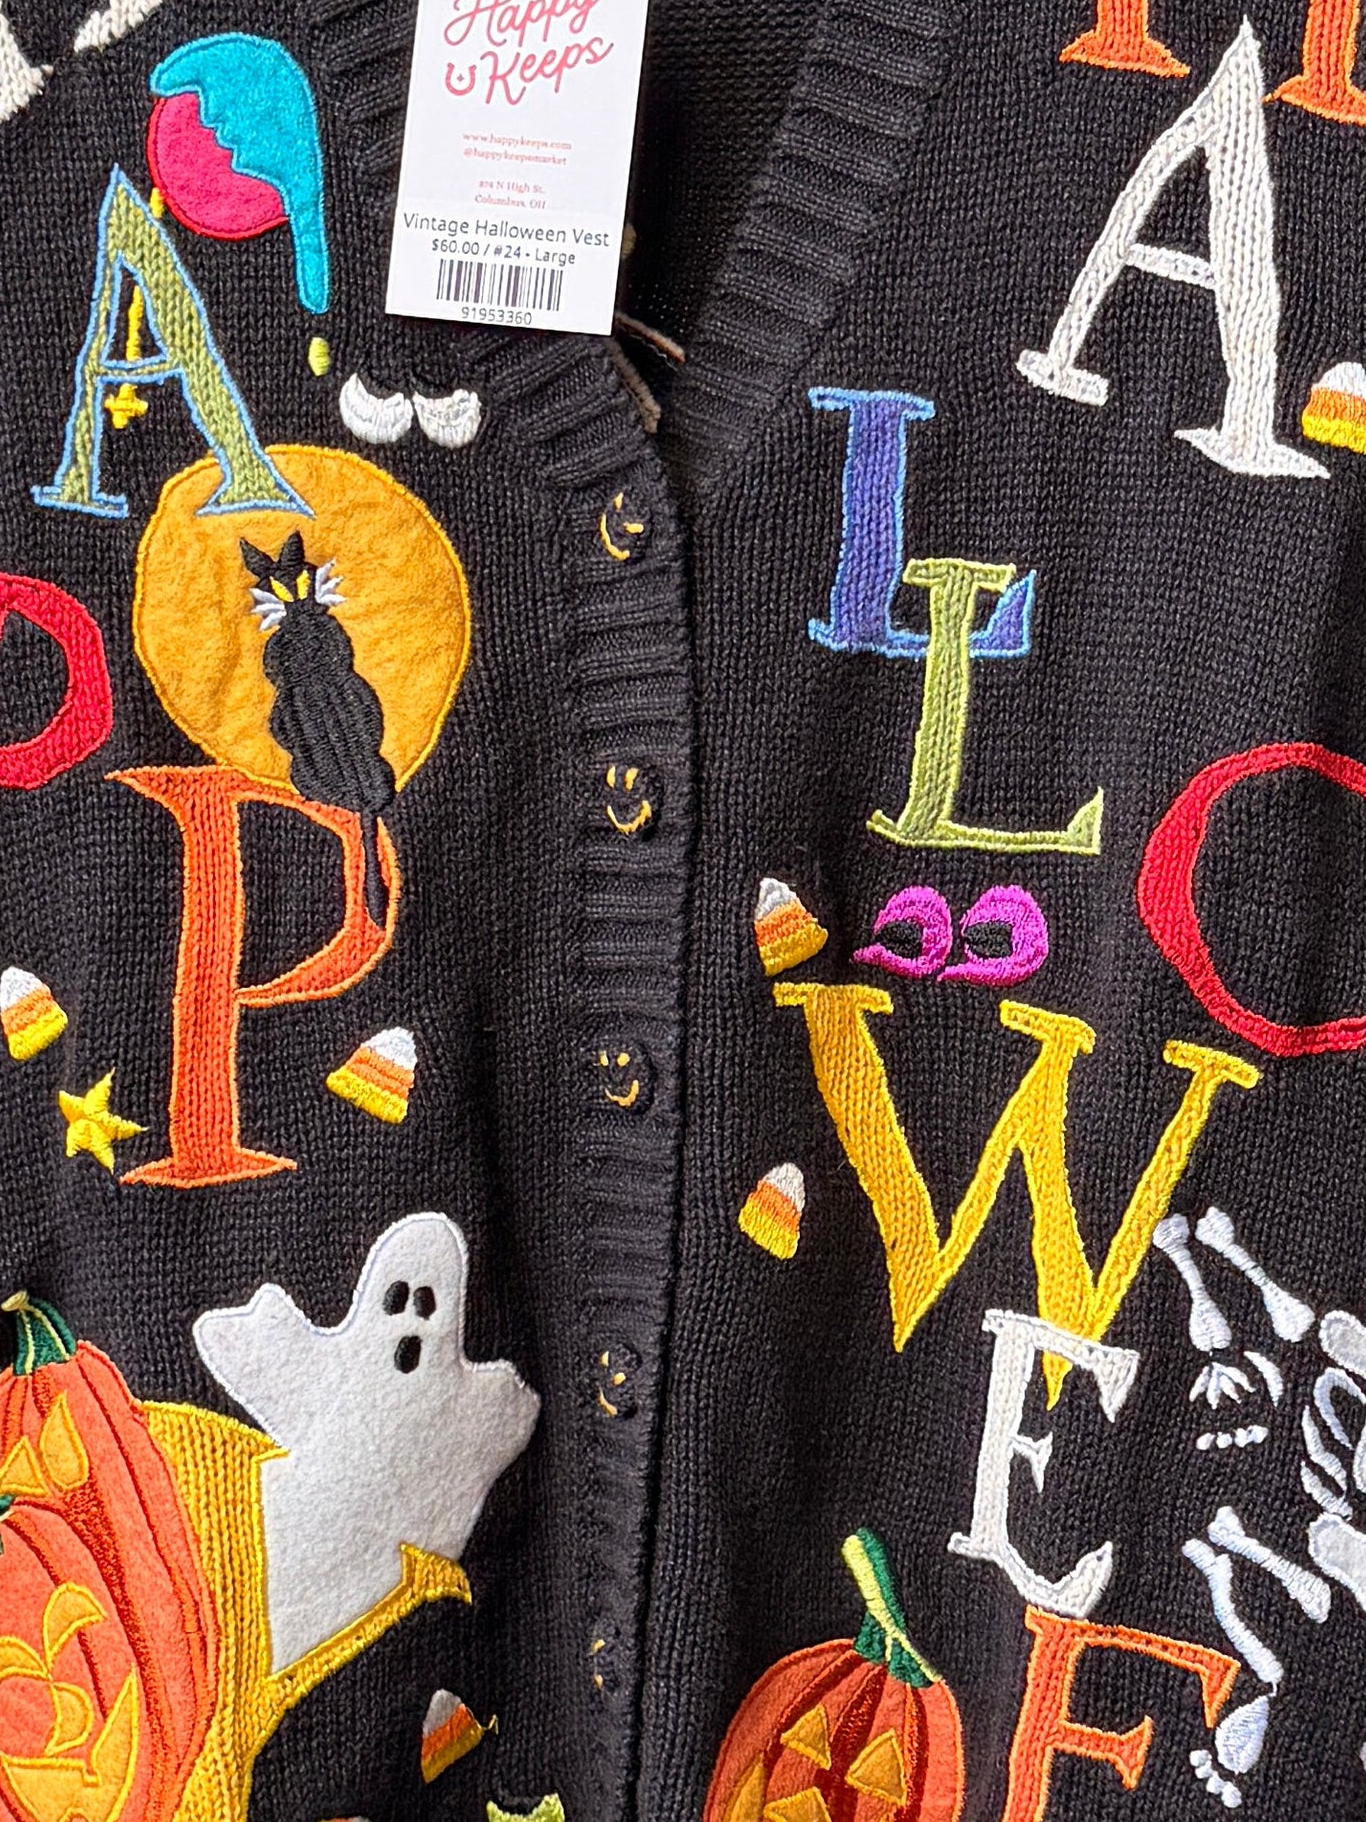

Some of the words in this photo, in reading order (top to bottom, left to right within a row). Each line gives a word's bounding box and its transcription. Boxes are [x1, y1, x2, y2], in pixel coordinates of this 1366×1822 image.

[480, 35, 614, 106] Keeps
[507, 181, 530, 193] High
[403, 213, 470, 236] Vintage
[475, 220, 567, 243] Halloween
[572, 229, 610, 247] Vest
[432, 238, 480, 256] $60.00
[494, 244, 522, 259] #24
[535, 248, 576, 267] Large
[461, 306, 533, 325] 91953360
